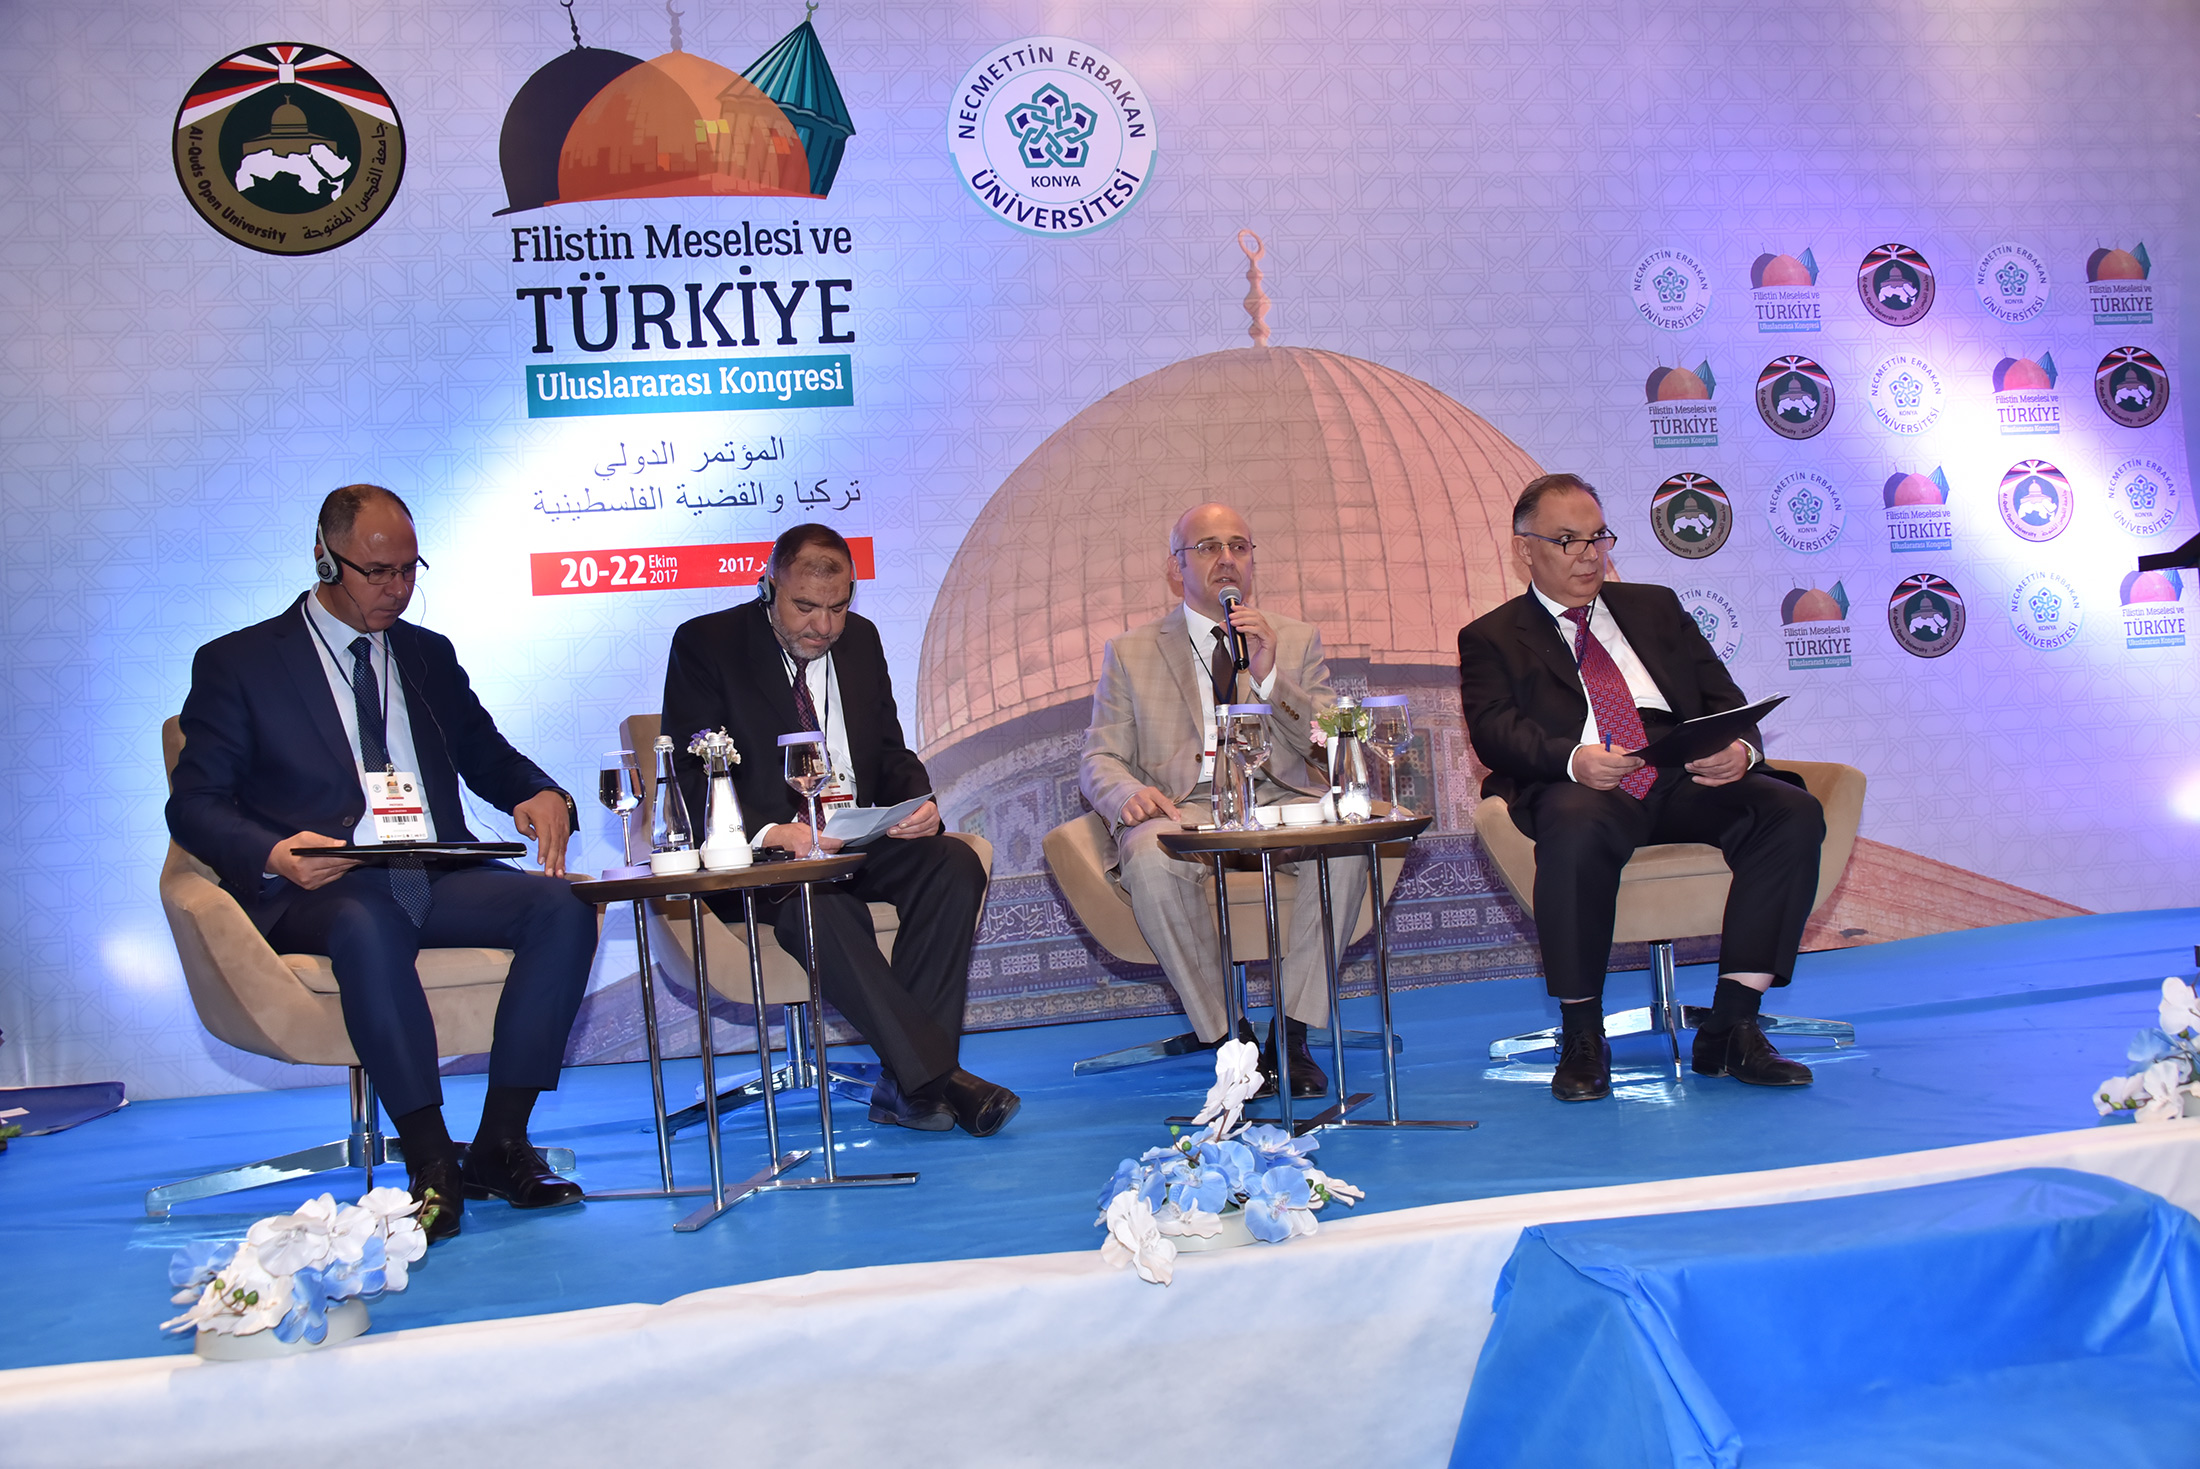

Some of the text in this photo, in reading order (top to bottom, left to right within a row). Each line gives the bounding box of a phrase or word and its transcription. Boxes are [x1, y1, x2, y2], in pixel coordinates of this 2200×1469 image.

[958, 44, 1146, 139] NECMETTİN ERBAKAN
[188, 126, 287, 244] Al-Quds Open University
[302, 122, 388, 240] جامعة القدس المفتوحة
[1031, 176, 1081, 188] KONYA
[972, 168, 1140, 229] ÜNİVERSİTESİ
[511, 220, 852, 263] Filistin Meselesi ve
[516, 265, 855, 354] TÜRKİYE
[1755, 301, 1821, 320] TÜRKİYE
[2090, 294, 2153, 312] TÜRKİYE
[536, 362, 844, 401] Uluslararası Kongresi
[1650, 415, 1718, 435] TÜRKİYE
[1997, 404, 2060, 423] TÜRKİYE
[594, 435, 786, 481] المؤتمر الدولي
[533, 486, 663, 523] الفلسطينية
[794, 478, 861, 512] تركيا
[1887, 519, 1952, 539] TÜRKİYE
[560, 554, 647, 588] 20-22
[649, 554, 678, 569] Ekim
[649, 570, 678, 584] 2017
[718, 557, 754, 574] 2017
[1707, 591, 1738, 628] ERBAKAN
[2124, 616, 2186, 636] TÜRKİYE
[1785, 636, 1852, 657] TÜRKİYE
